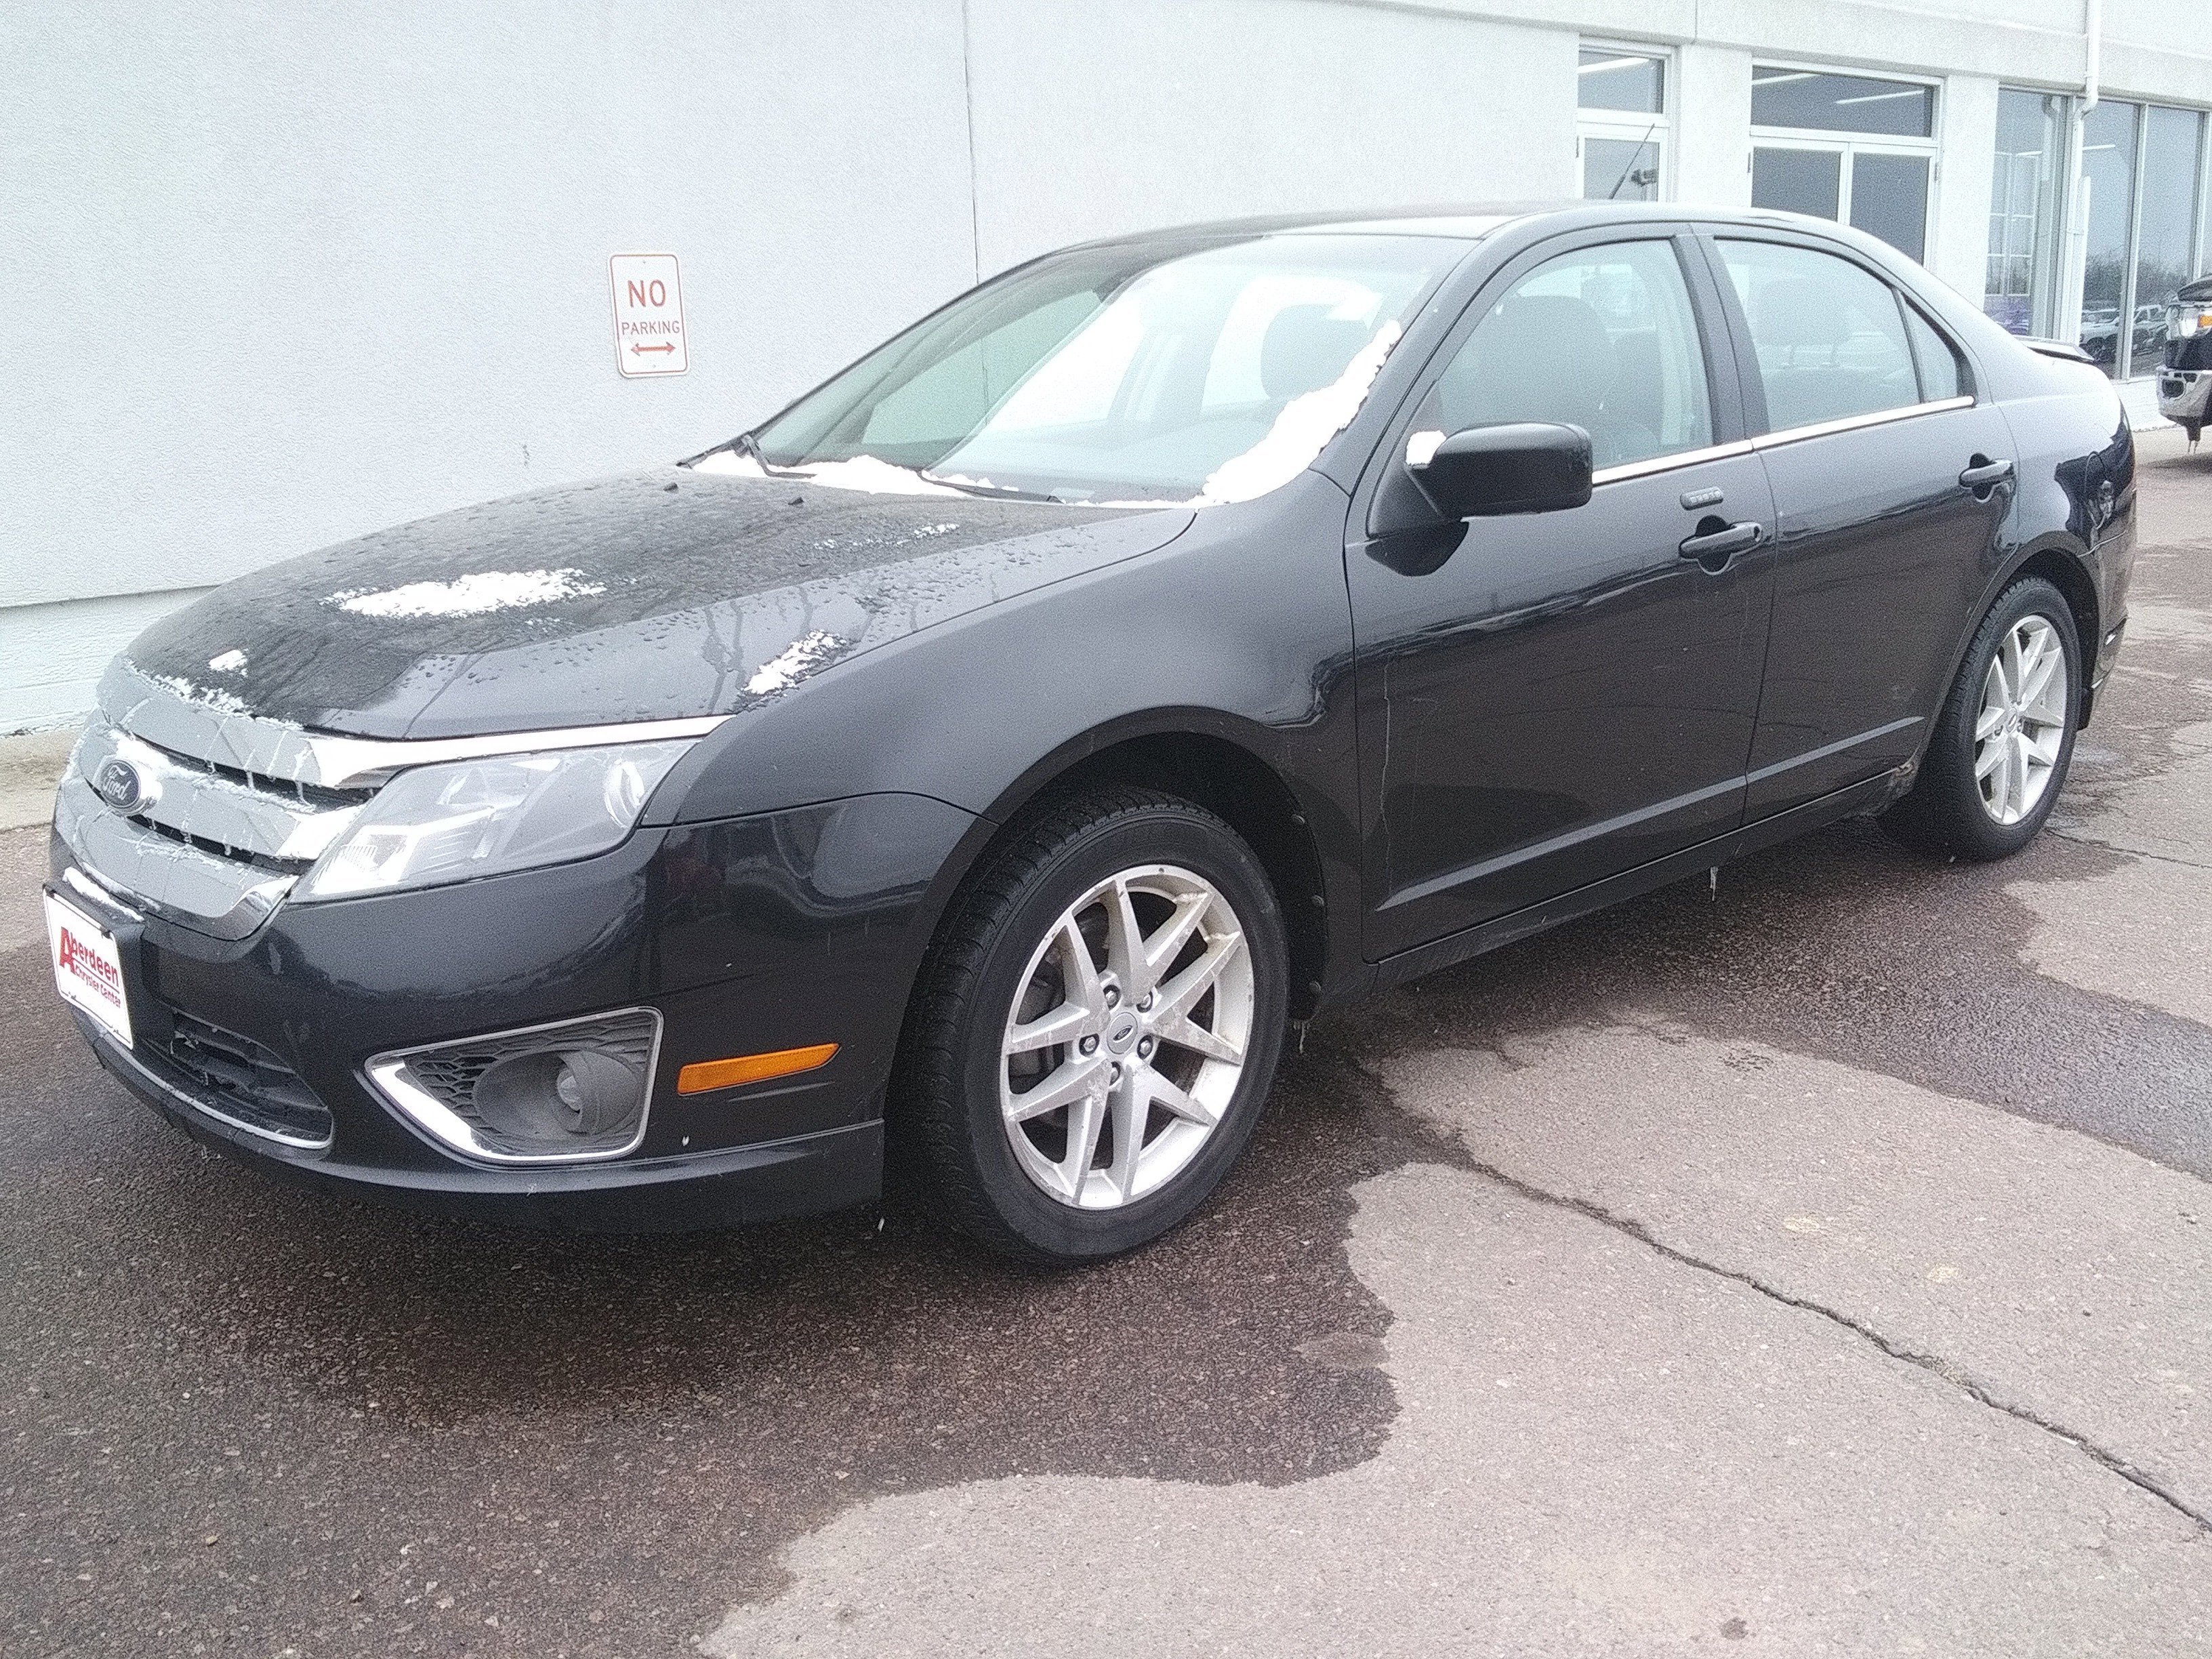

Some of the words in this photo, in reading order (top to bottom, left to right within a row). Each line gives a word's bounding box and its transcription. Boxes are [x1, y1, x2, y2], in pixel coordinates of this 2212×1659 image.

[627, 279, 666, 308] NO
[621, 321, 680, 335] PARKING
[102, 764, 131, 800] Ford
[59, 926, 119, 987] Aberdeen
